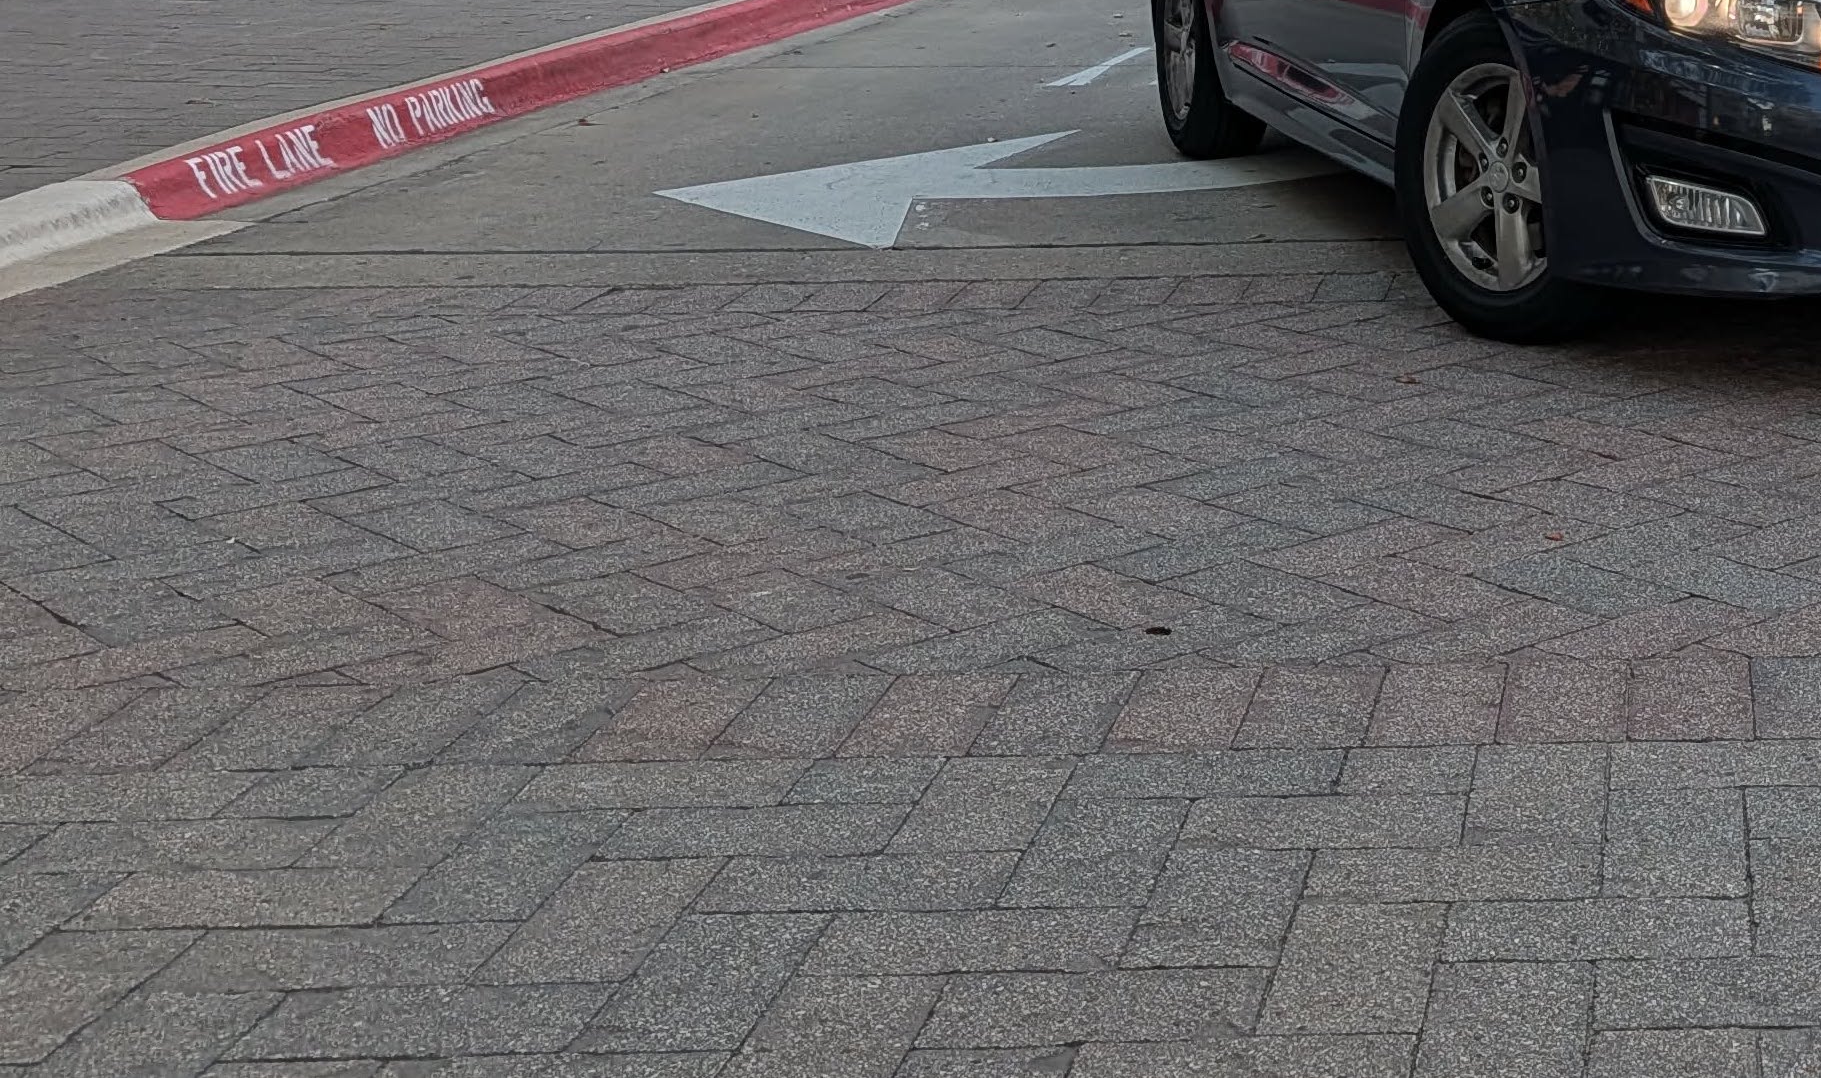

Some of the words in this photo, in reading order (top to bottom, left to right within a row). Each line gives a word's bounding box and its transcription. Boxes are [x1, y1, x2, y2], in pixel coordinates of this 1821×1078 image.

[366, 102, 407, 151] NO
[404, 78, 496, 137] PARKING
[184, 145, 264, 200] FIRE
[255, 124, 337, 180] LANE
